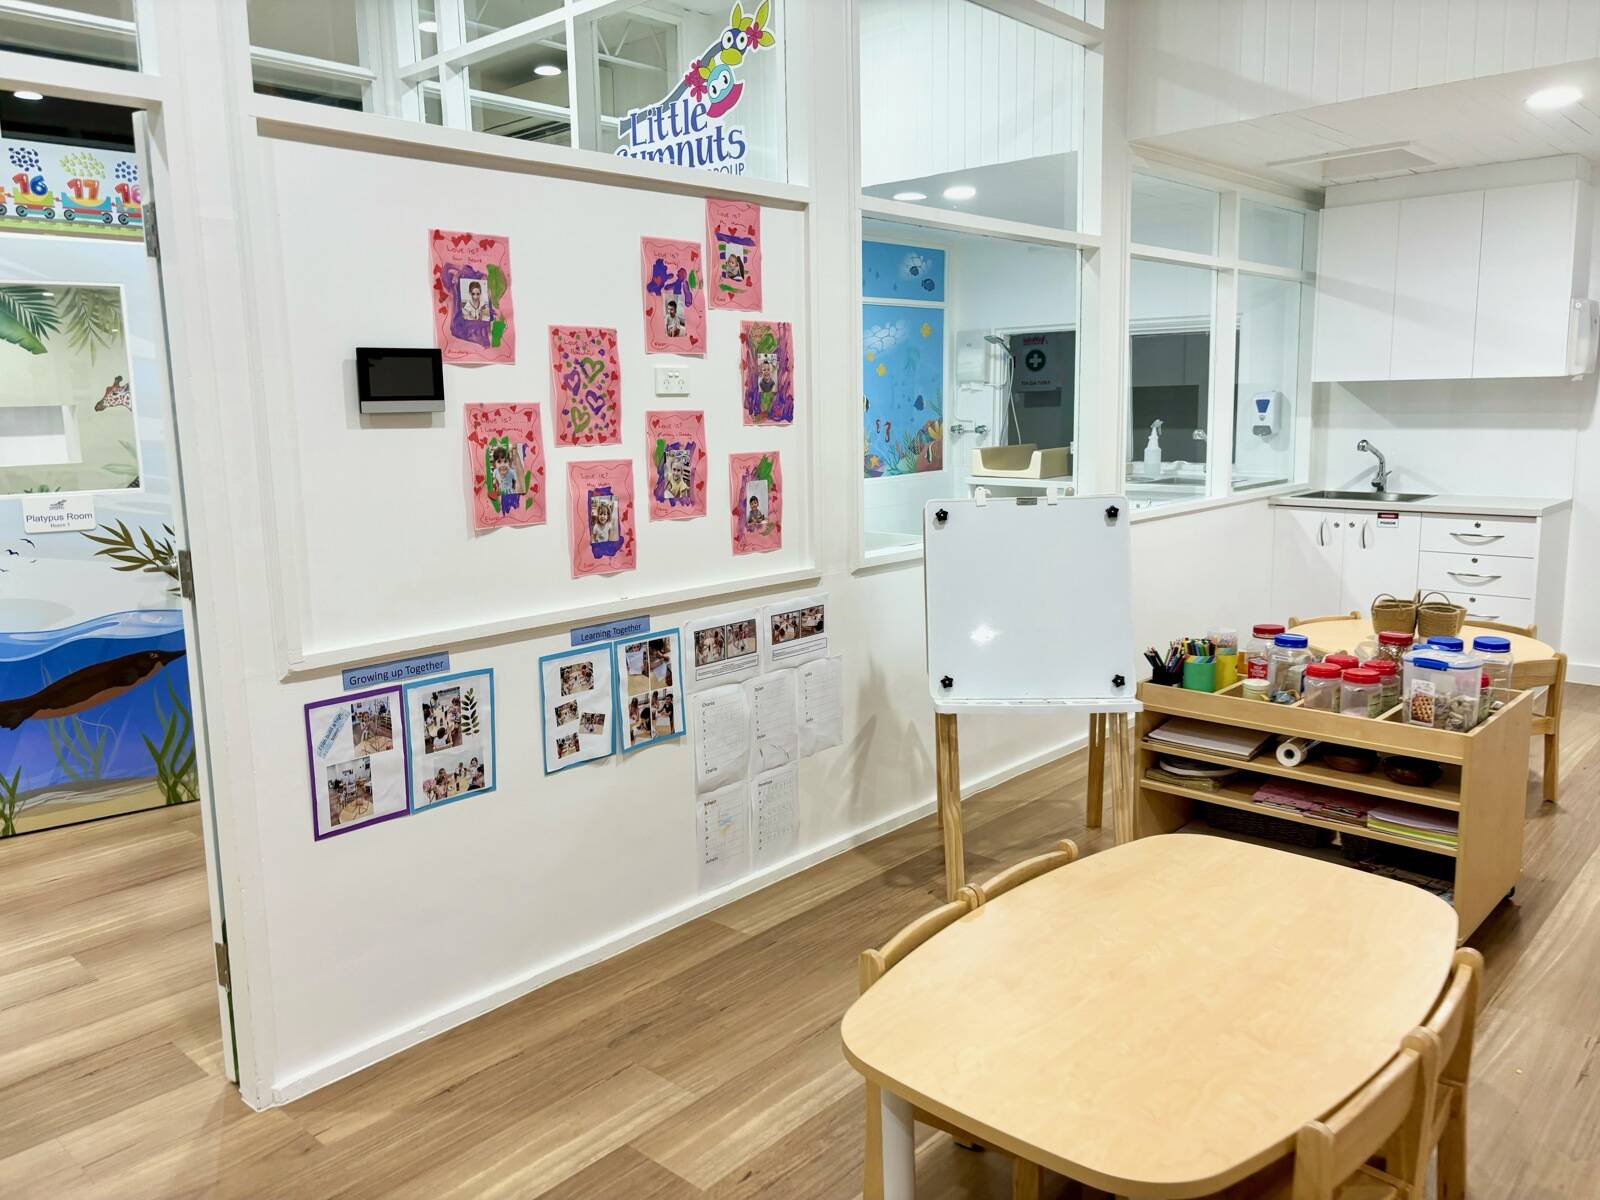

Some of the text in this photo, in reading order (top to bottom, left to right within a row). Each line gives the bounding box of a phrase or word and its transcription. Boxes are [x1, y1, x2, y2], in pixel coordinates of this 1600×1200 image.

[630, 98, 708, 147] Little
[616, 125, 746, 168] mnuts
[12, 172, 49, 196] 16
[67, 178, 100, 200] 17
[26, 512, 93, 523] Platypus Room
[580, 623, 641, 641] Learning Together
[349, 660, 444, 685] Growing up Together
